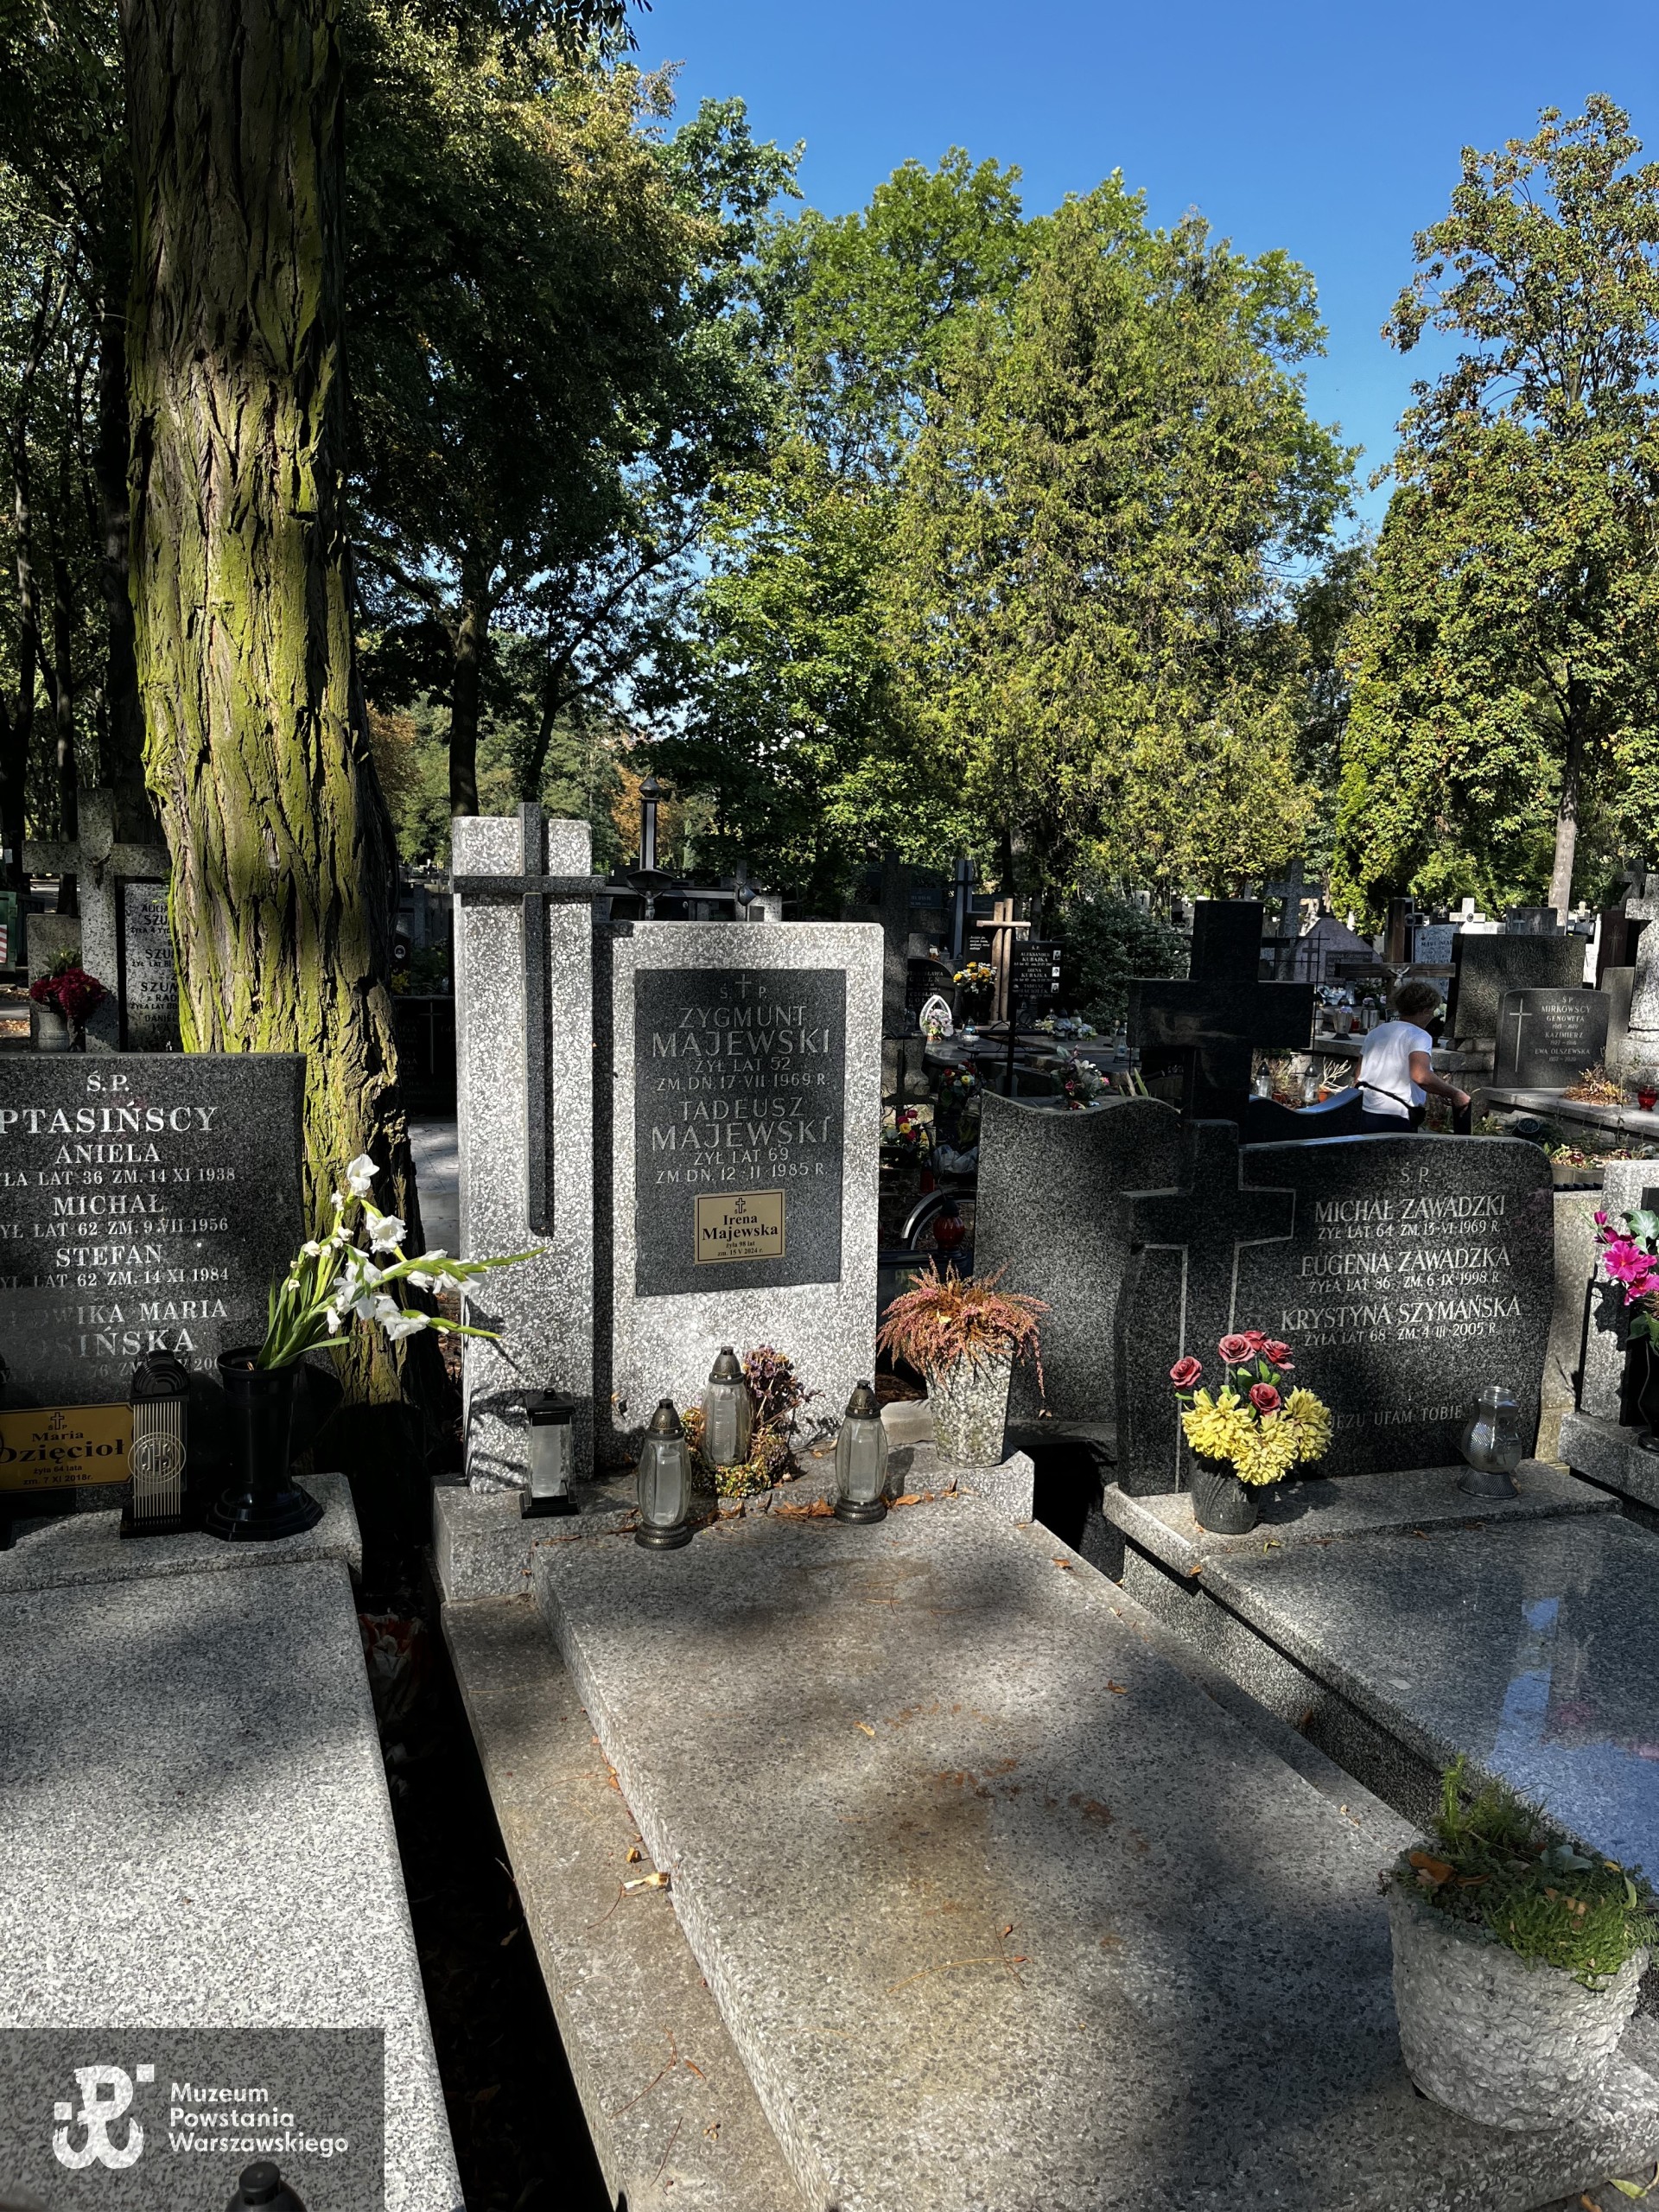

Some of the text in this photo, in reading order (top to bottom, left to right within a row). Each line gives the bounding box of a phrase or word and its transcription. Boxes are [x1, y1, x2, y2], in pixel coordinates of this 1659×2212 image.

[144, 915, 170, 925] SZU
[679, 1006, 807, 1028] ZYGMUNT
[1541, 1005, 1591, 1014] MIRKOWSCY
[652, 1028, 830, 1058] MAJEWSKI
[734, 1058, 763, 1072] LAT
[770, 1056, 791, 1071] 52
[0, 1101, 218, 1135] PTASIŃSCY
[679, 1096, 804, 1121] TADEUSZ
[652, 1116, 831, 1151] MAJEWSKI
[54, 1143, 162, 1165] ANIELA
[734, 1149, 761, 1164] LAT
[768, 1147, 789, 1162] 69
[39, 1171, 73, 1186] LAT
[83, 1171, 104, 1185] 36
[112, 1169, 143, 1185] ZM.
[150, 1169, 167, 1183] 14
[174, 1167, 192, 1183] XI
[199, 1166, 236, 1182] 1938
[687, 1168, 715, 1182] DN.
[53, 1193, 165, 1217] MICHAŁ
[1314, 1195, 1506, 1223] MICHAŁ ZAWADZKI
[35, 1222, 69, 1238] LAT
[78, 1221, 99, 1236] 62
[108, 1220, 139, 1236] ZM.
[143, 1220, 154, 1235] 9
[192, 1217, 229, 1233] 1956
[723, 1214, 758, 1225] Irena
[702, 1224, 779, 1242] Majewska
[1348, 1224, 1371, 1238] LAT
[1376, 1223, 1394, 1237] 64
[1400, 1224, 1420, 1236] ZM.
[56, 1244, 163, 1268] STEFAN
[1300, 1246, 1511, 1277] EUGENIA ZAWADZKA
[34, 1274, 68, 1288] LAT
[77, 1273, 97, 1287] 62
[107, 1271, 137, 1287] ZM.
[144, 1270, 162, 1285] 14
[167, 1269, 185, 1283] XI
[192, 1267, 229, 1281] 1984
[1346, 1278, 1370, 1292] LAT
[1375, 1275, 1392, 1290] 86
[1403, 1274, 1422, 1288] ZM.
[139, 1299, 228, 1322] MARIA
[1281, 1295, 1522, 1332] KRYSTYNA SZYMAŃSKA
[1342, 1331, 1364, 1344] LAT
[1370, 1329, 1386, 1342] 68
[1397, 1327, 1416, 1340] ZM.
[1374, 1409, 1413, 1426] UFAM
[1421, 1405, 1463, 1422] TOBIE
[32, 1430, 84, 1442] Maria
[0, 1439, 125, 1465] Dzięcioł
[35, 1466, 52, 1475] żyła
